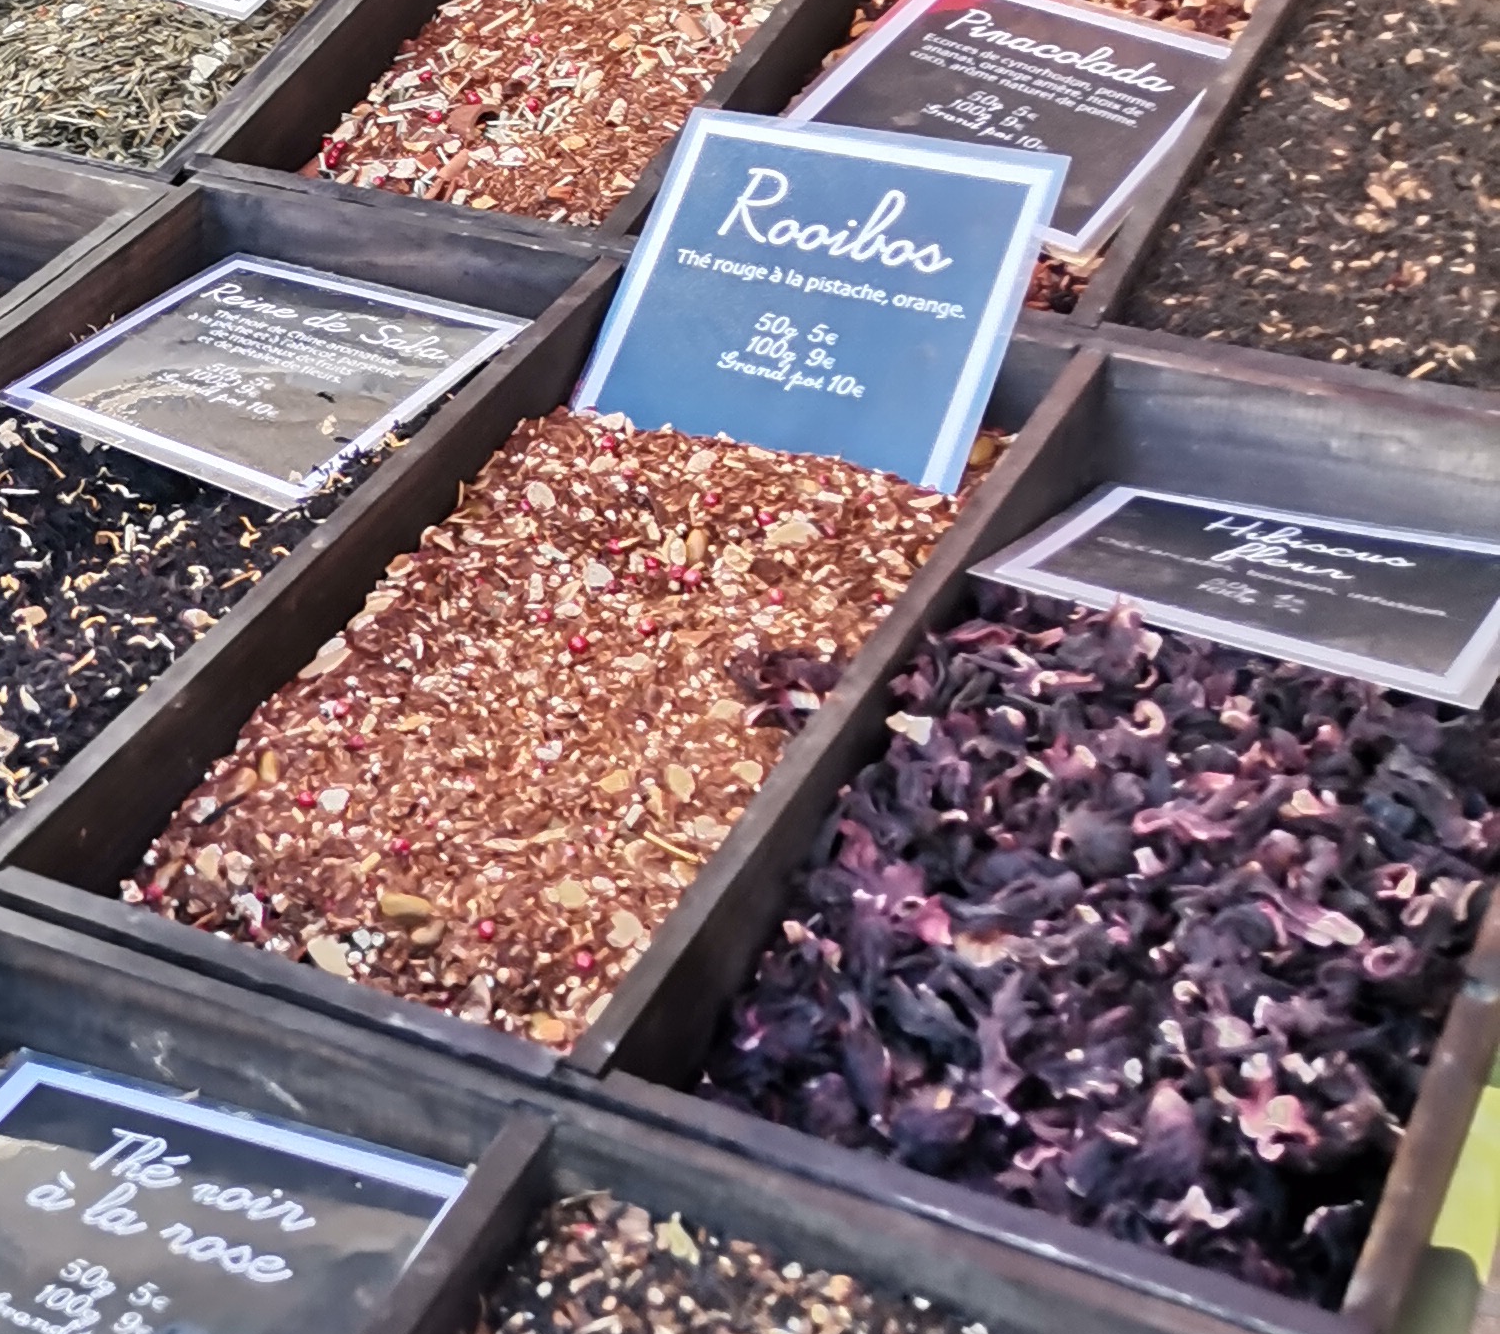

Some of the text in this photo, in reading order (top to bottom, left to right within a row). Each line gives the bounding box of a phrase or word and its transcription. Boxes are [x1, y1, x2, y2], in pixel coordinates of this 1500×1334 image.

[922, 32, 979, 56] Ecorces
[980, 50, 1001, 62] de
[944, 8, 1175, 92] Pinacolada
[979, 60, 1145, 118] orange de
[1055, 92, 1076, 107] de
[717, 167, 953, 273] Rooibos
[677, 248, 966, 319] Thé rouge à la pistache, orange.
[200, 282, 451, 361] Reine de Saba
[213, 309, 327, 347] Thé noir de Chine
[754, 312, 839, 346] 50g 5€
[197, 335, 299, 371] et de pétales de
[209, 328, 352, 376] de morceaux de fruits
[717, 351, 867, 398] Grand pot 10€
[746, 336, 837, 370] 100g 9€
[1203, 516, 1417, 568] Hibiscus
[1209, 542, 1355, 580] fleur
[89, 1128, 317, 1232] Thé noir
[26, 1170, 294, 1283] à la rose
[34, 1283, 101, 1332] 100g
[59, 1258, 172, 1314] 50g 5€
